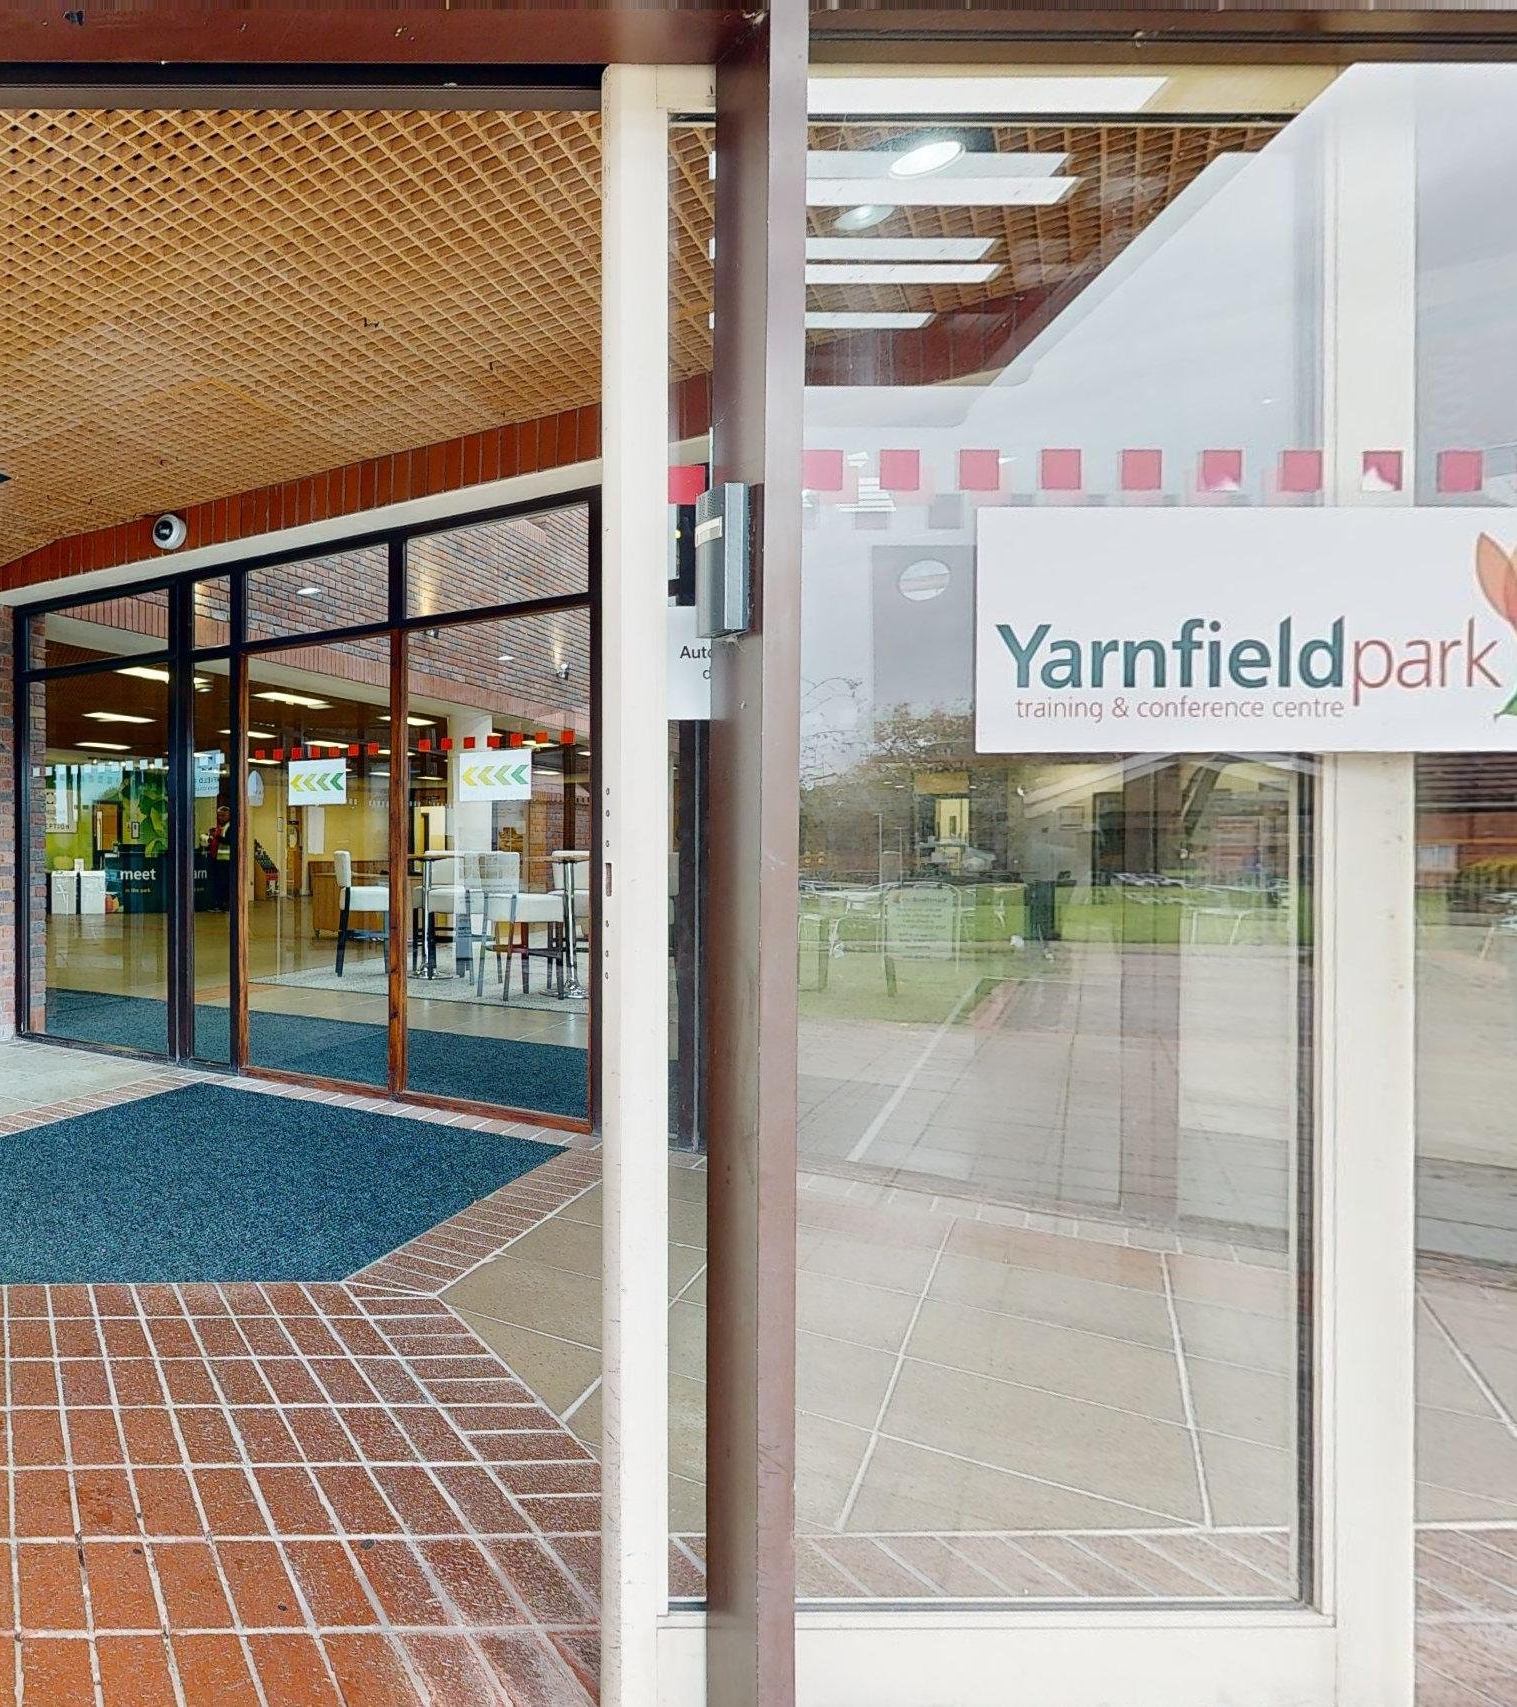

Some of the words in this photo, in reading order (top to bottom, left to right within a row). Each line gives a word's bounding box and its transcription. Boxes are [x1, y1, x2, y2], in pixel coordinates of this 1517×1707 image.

[1015, 697, 1103, 724] training
[1111, 697, 1129, 719] &
[1136, 696, 1265, 719] conference
[1273, 698, 1345, 718] centre
[119, 868, 157, 881] meet
